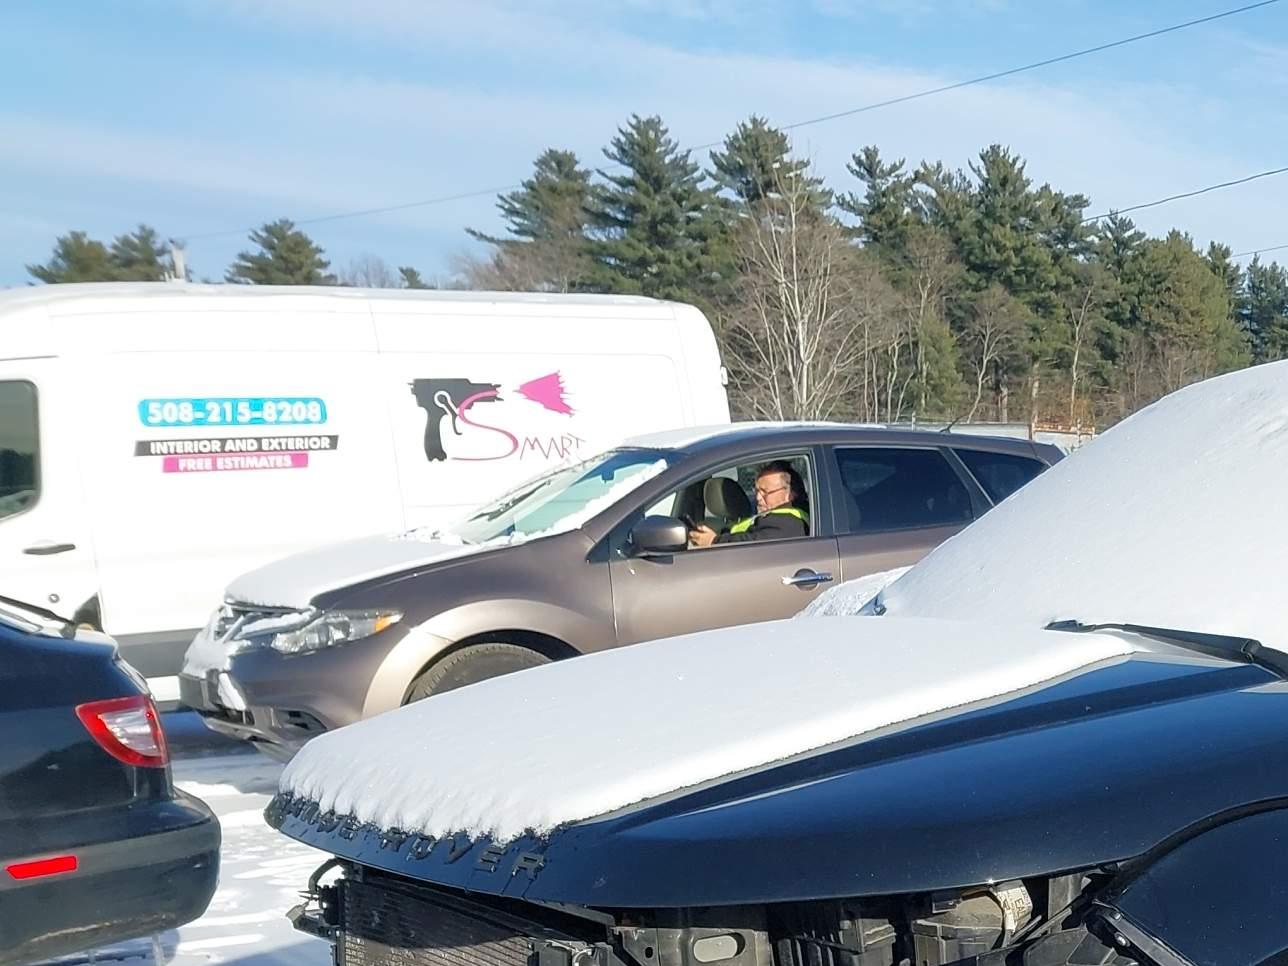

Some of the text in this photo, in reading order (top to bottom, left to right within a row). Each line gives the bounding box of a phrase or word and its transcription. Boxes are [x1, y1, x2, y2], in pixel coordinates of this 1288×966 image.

[146, 401, 322, 424] 508-215-8208
[150, 436, 330, 455] INTERIOR AND EXTERIOR
[178, 454, 293, 472] FREE ESTIMATES
